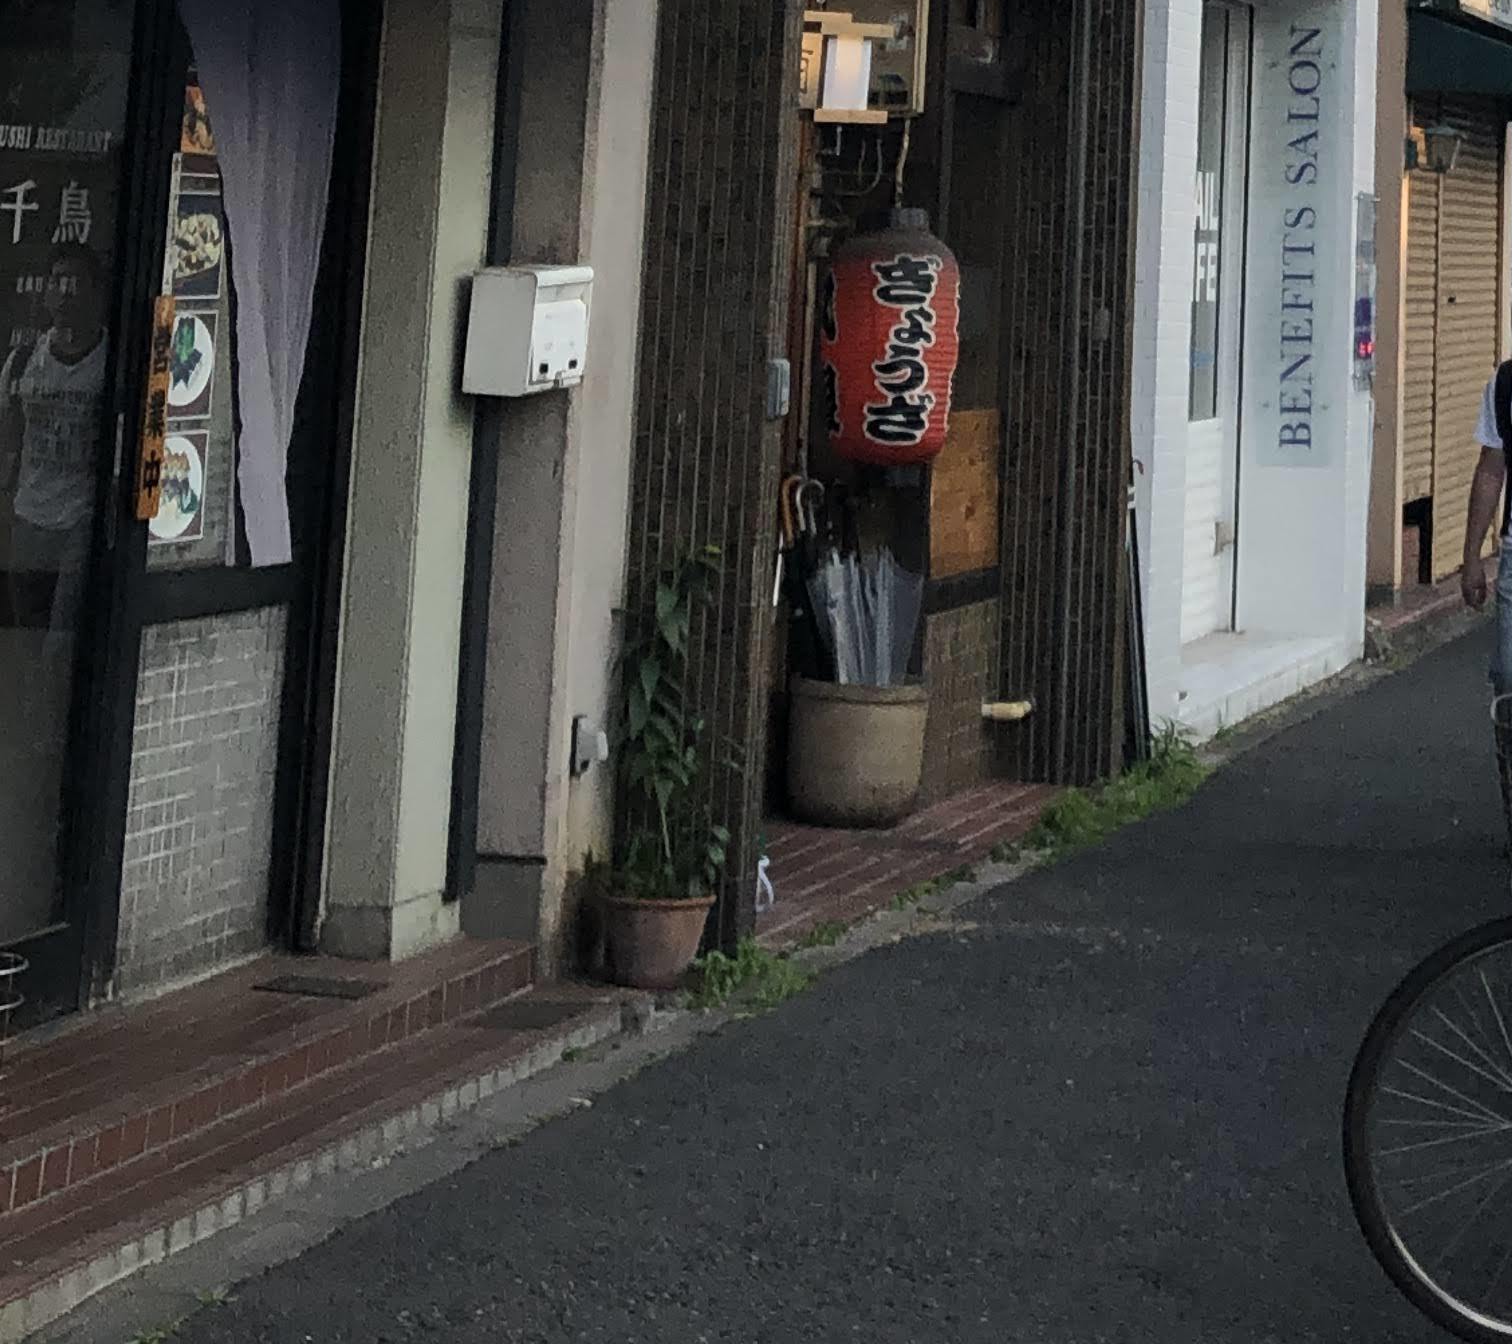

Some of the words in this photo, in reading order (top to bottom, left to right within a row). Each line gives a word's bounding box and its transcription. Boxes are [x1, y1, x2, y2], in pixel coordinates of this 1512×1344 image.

[1284, 24, 1323, 186] SALON
[0, 179, 92, 245] 千鳥
[863, 253, 944, 447] ぎょうざ
[1278, 206, 1317, 450] BENEFITS
